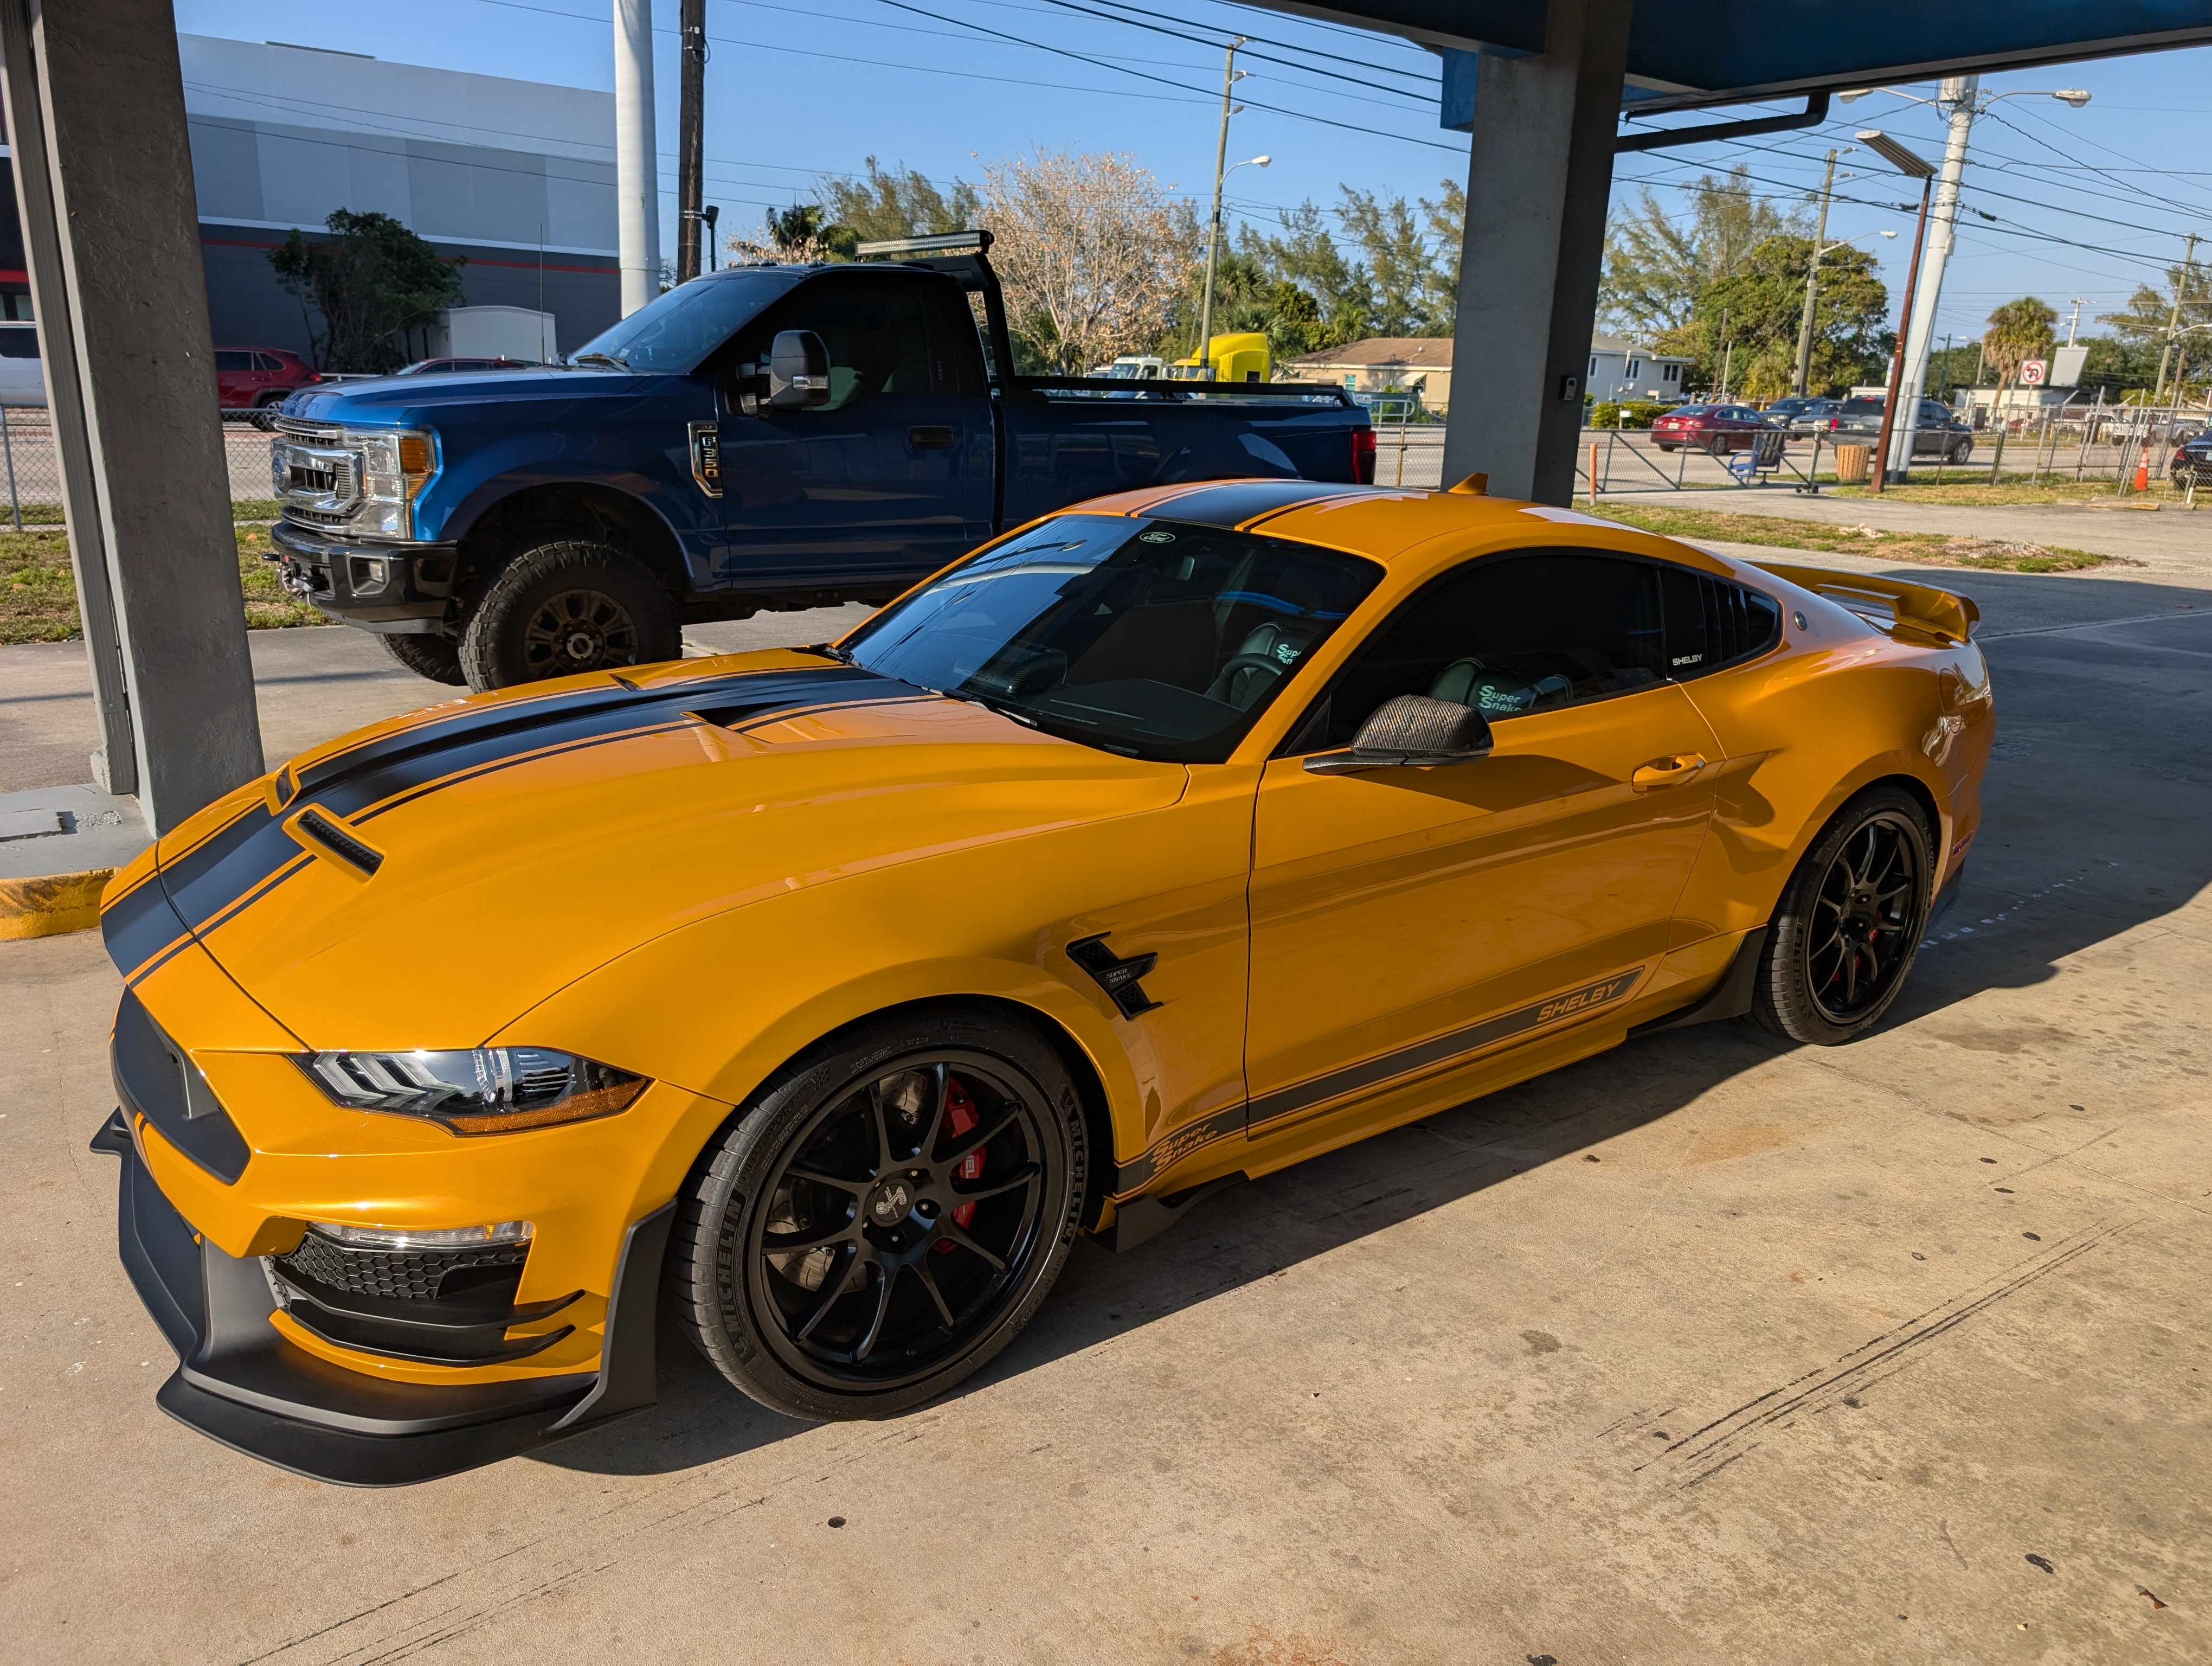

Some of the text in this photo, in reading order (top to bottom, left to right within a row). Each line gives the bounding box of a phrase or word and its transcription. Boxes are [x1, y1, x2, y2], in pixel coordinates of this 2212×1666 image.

[1143, 533, 1171, 542] Ford
[1673, 653, 1702, 666] SHELBY
[1478, 685, 1521, 703] Super
[1106, 968, 1128, 979] SUPER
[1109, 972, 1132, 984] SNAKE
[1536, 981, 1621, 1022] SHELBY
[741, 1144, 764, 1181] PILOT
[765, 1099, 796, 1140] SPORT
[1150, 1123, 1212, 1163] Super
[1154, 1130, 1218, 1172] Snake
[1065, 1119, 1083, 1238] MICHELIN
[717, 1196, 743, 1333] MICHELIN
